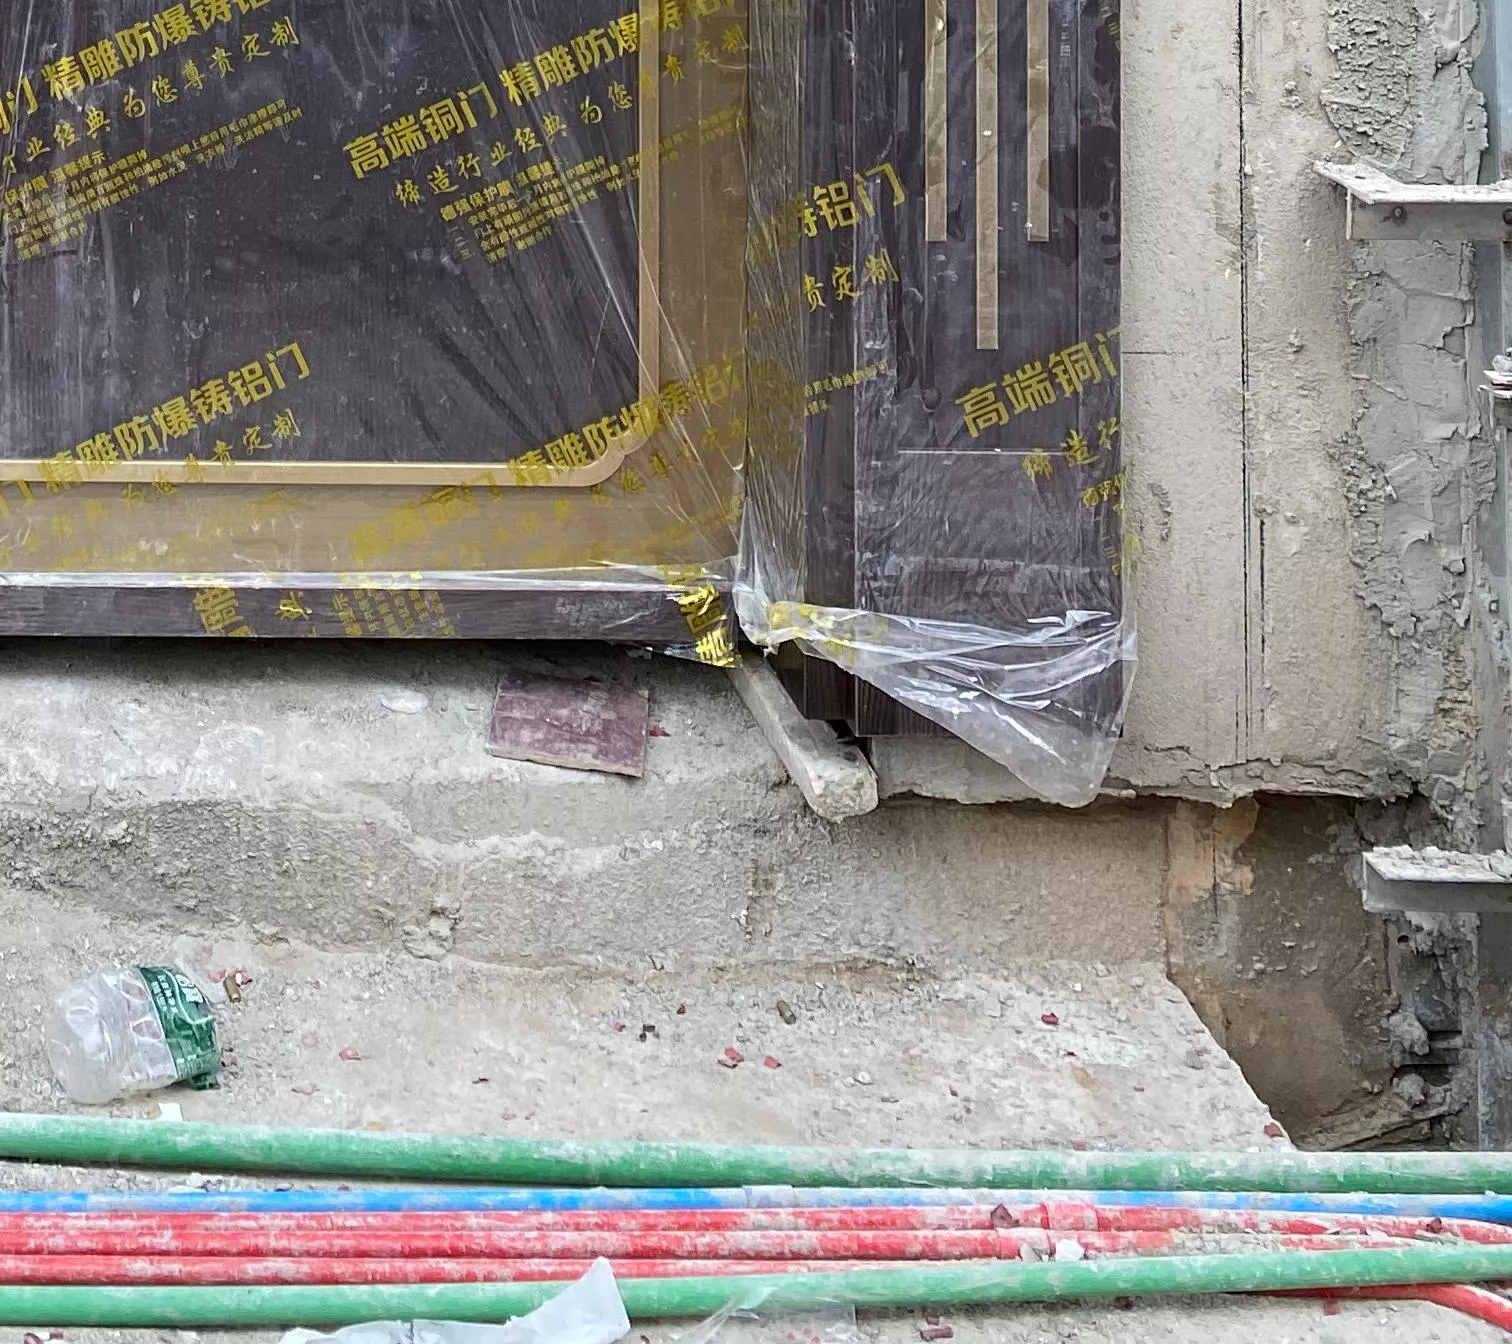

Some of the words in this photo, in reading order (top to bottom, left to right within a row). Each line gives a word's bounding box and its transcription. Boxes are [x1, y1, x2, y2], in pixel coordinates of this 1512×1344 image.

[121, 17, 301, 117] 为您尊贵定制
[343, 80, 500, 177] 高端铜门
[395, 111, 571, 207] 缔造行业经典
